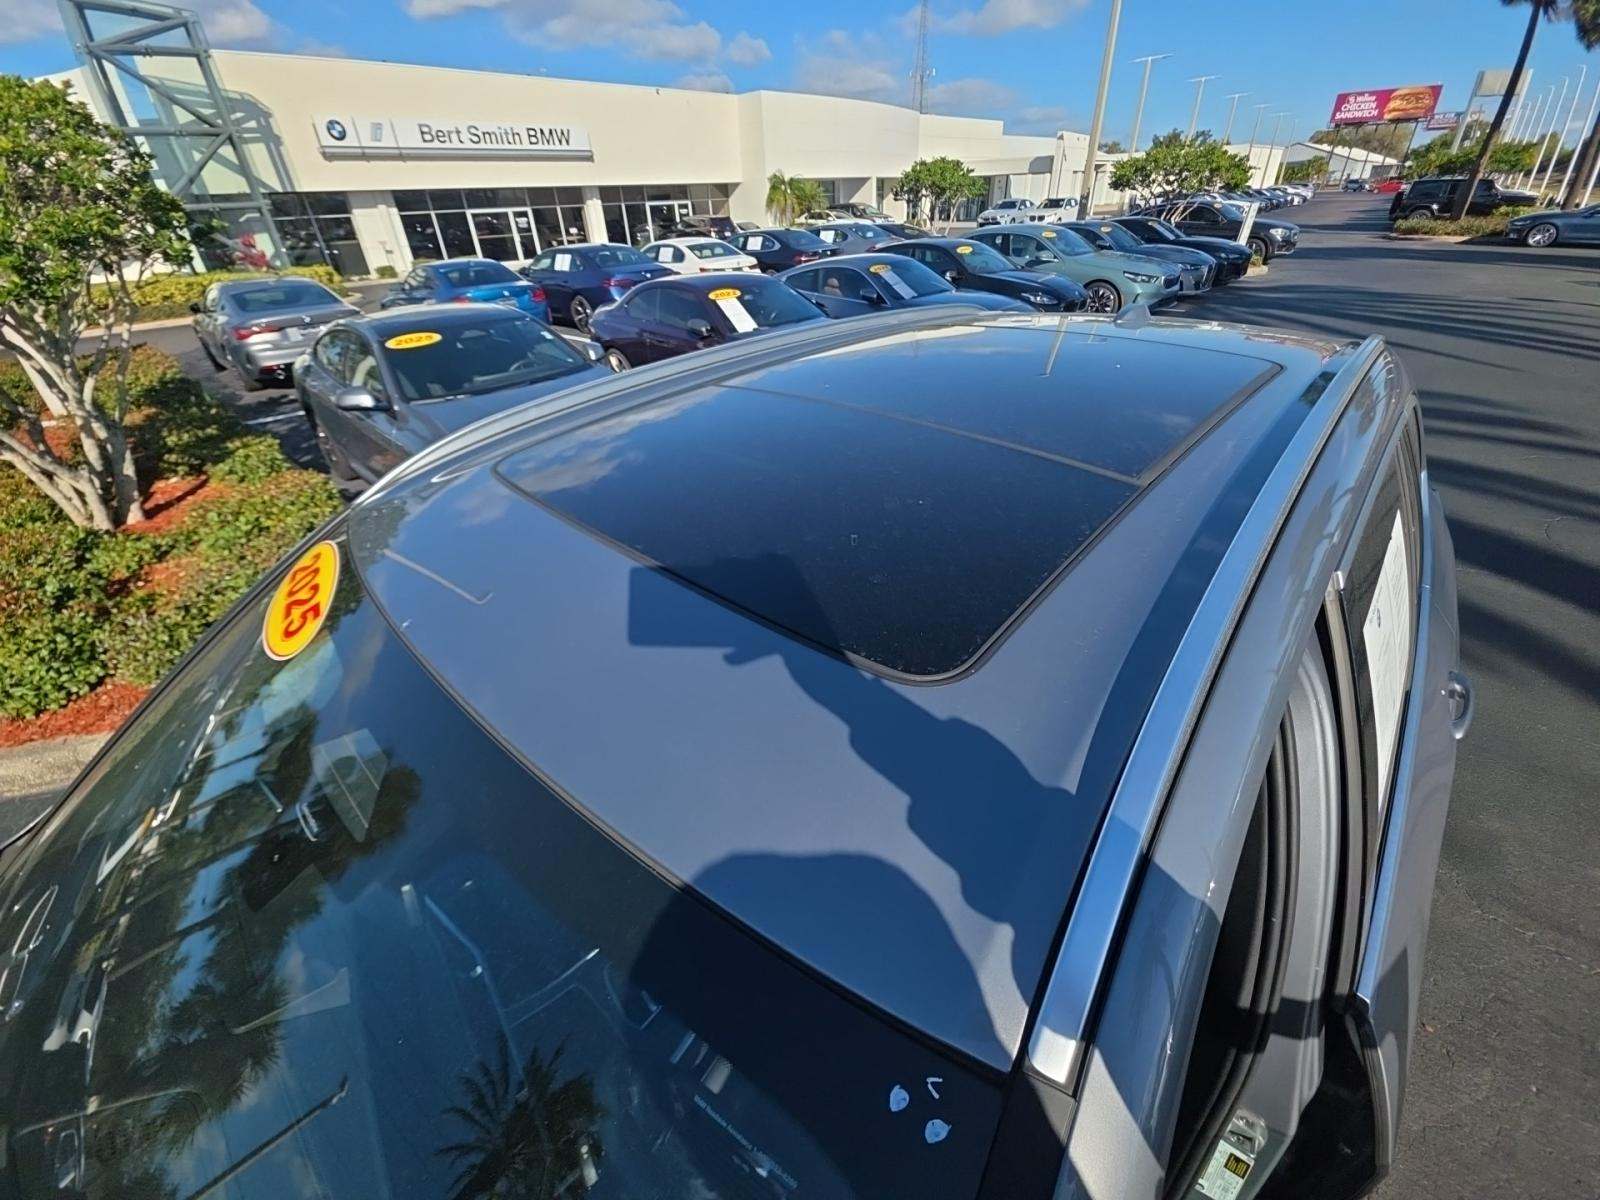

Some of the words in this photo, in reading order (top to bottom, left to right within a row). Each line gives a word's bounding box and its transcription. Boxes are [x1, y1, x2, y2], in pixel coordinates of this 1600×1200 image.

[1335, 109, 1378, 119] SANDWICH
[1341, 102, 1377, 111] CHICKEN
[417, 123, 464, 144] Bert
[467, 125, 523, 145] Smith
[526, 127, 570, 146] BMW
[284, 552, 321, 639] 2025
